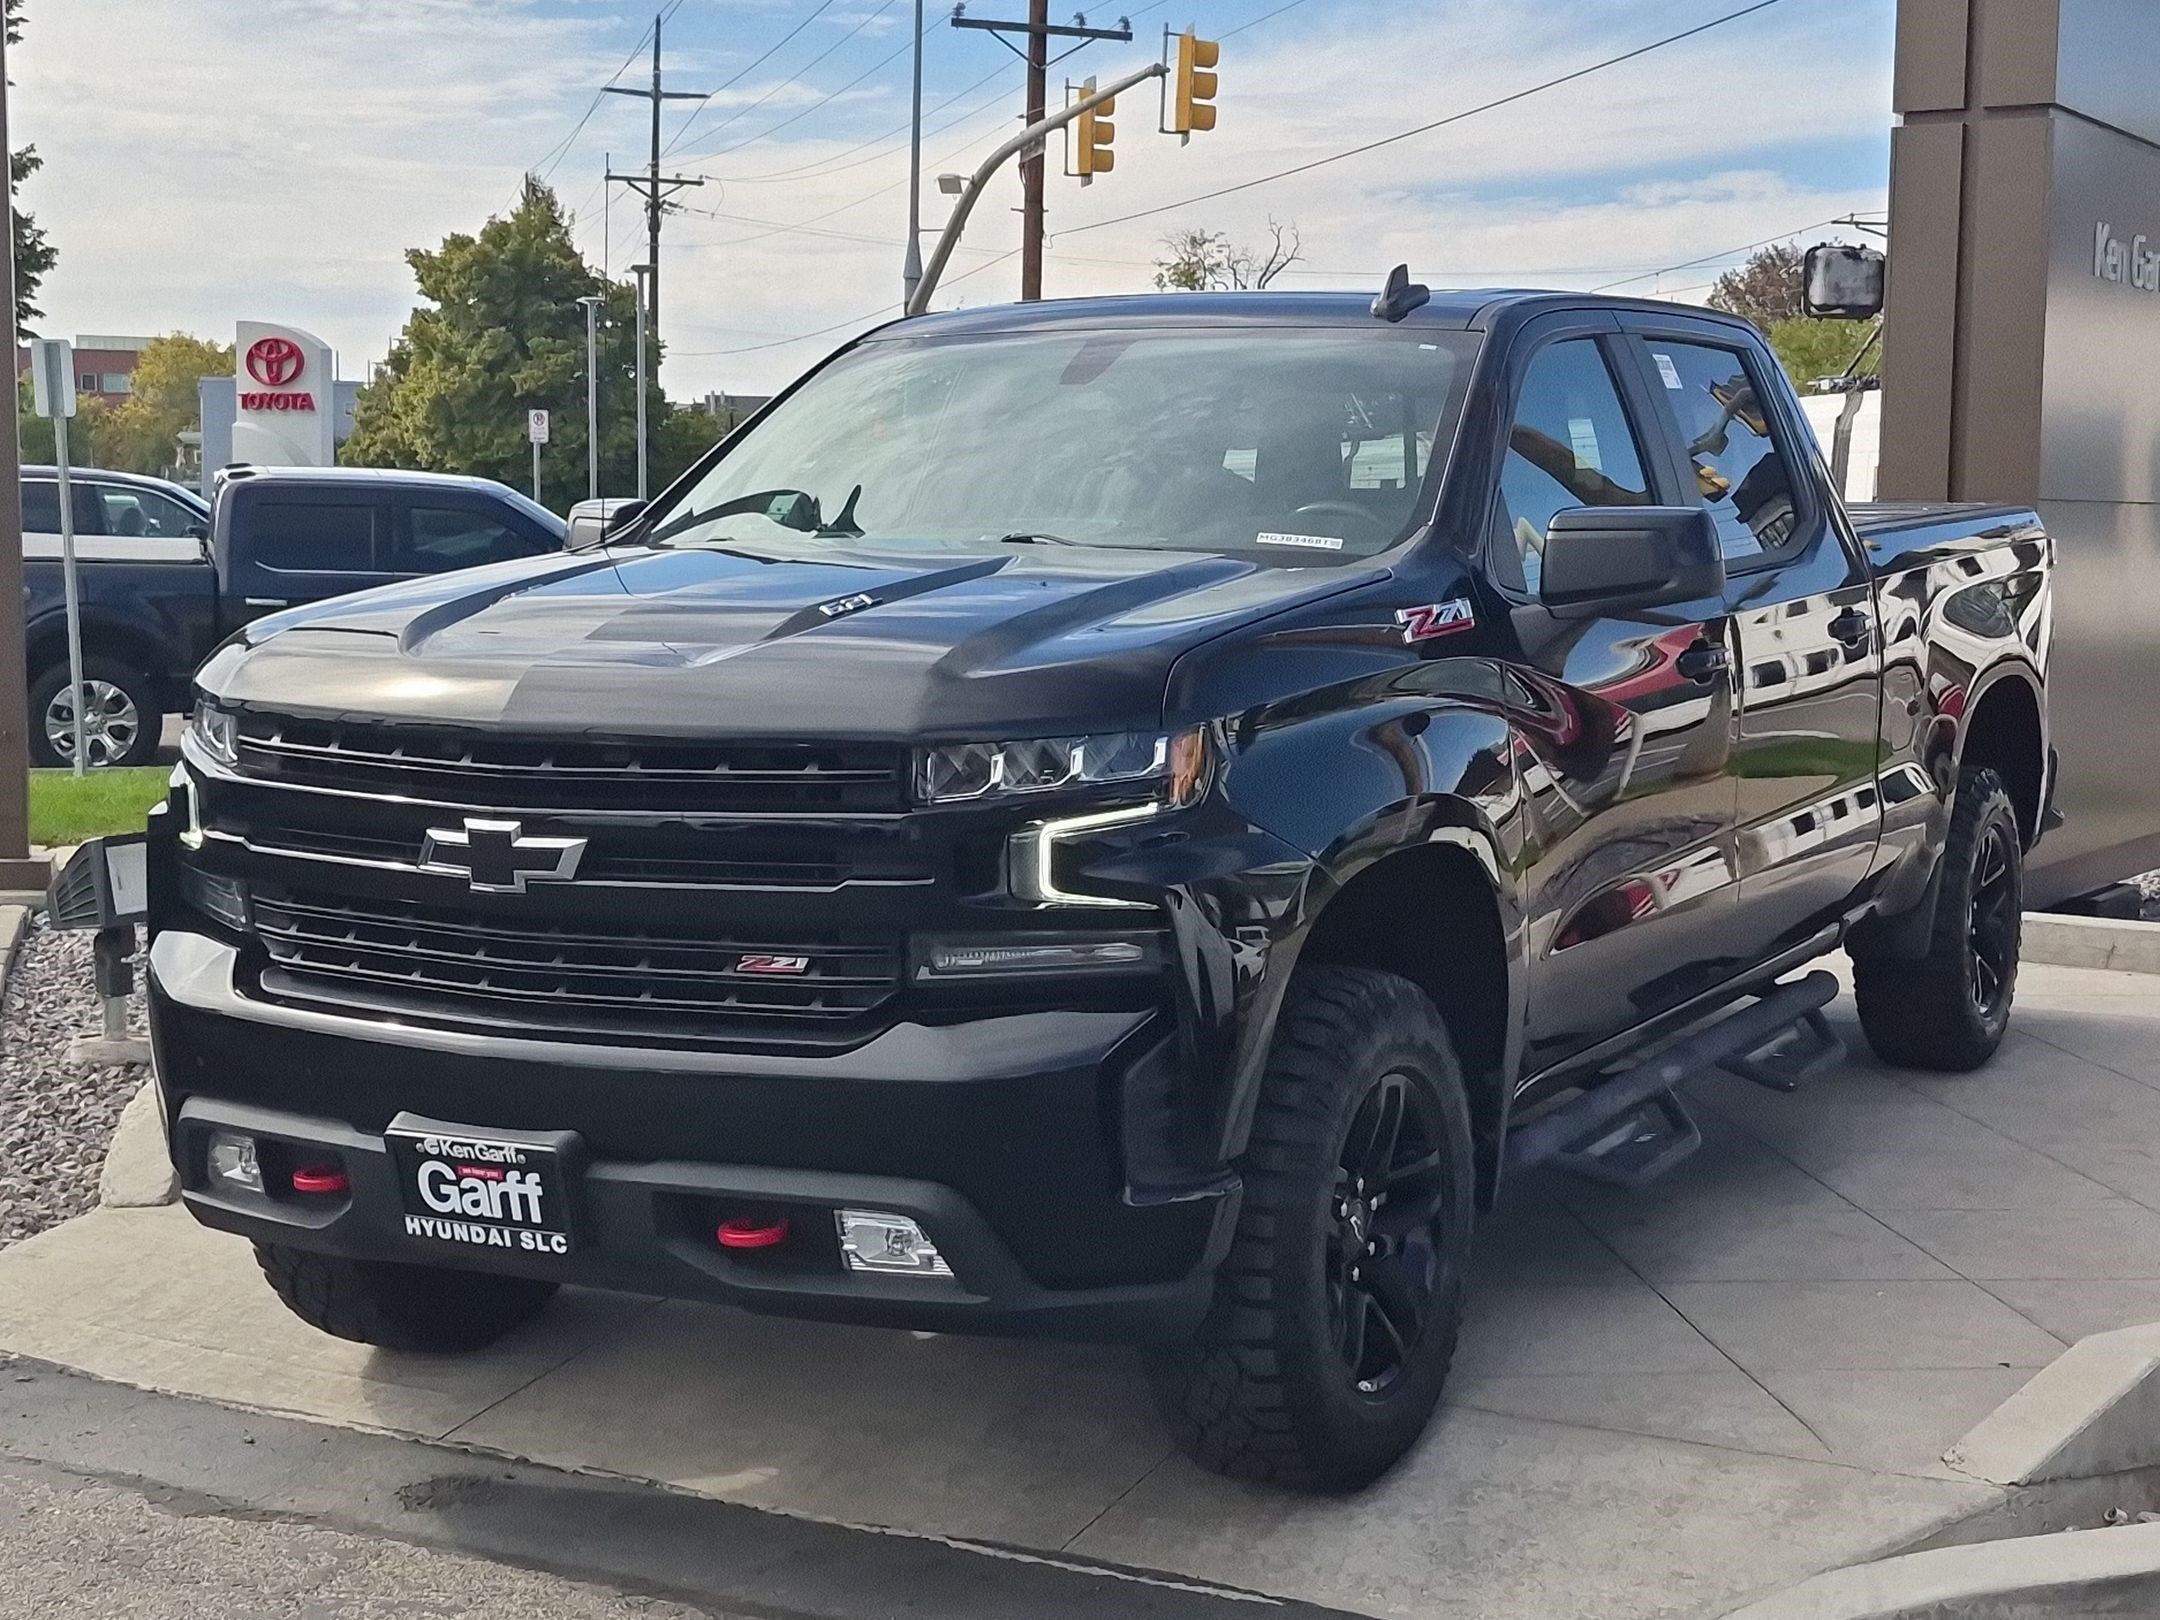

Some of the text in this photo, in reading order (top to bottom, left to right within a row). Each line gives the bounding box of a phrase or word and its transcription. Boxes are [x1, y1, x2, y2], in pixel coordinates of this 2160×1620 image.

[2093, 221, 2129, 283] Ken
[238, 392, 315, 411] TOYOTA
[1394, 597, 1476, 645] Z71
[736, 954, 809, 973] Z71
[417, 1160, 544, 1224] Garff
[404, 1216, 568, 1254] HYUNDAI SLC
